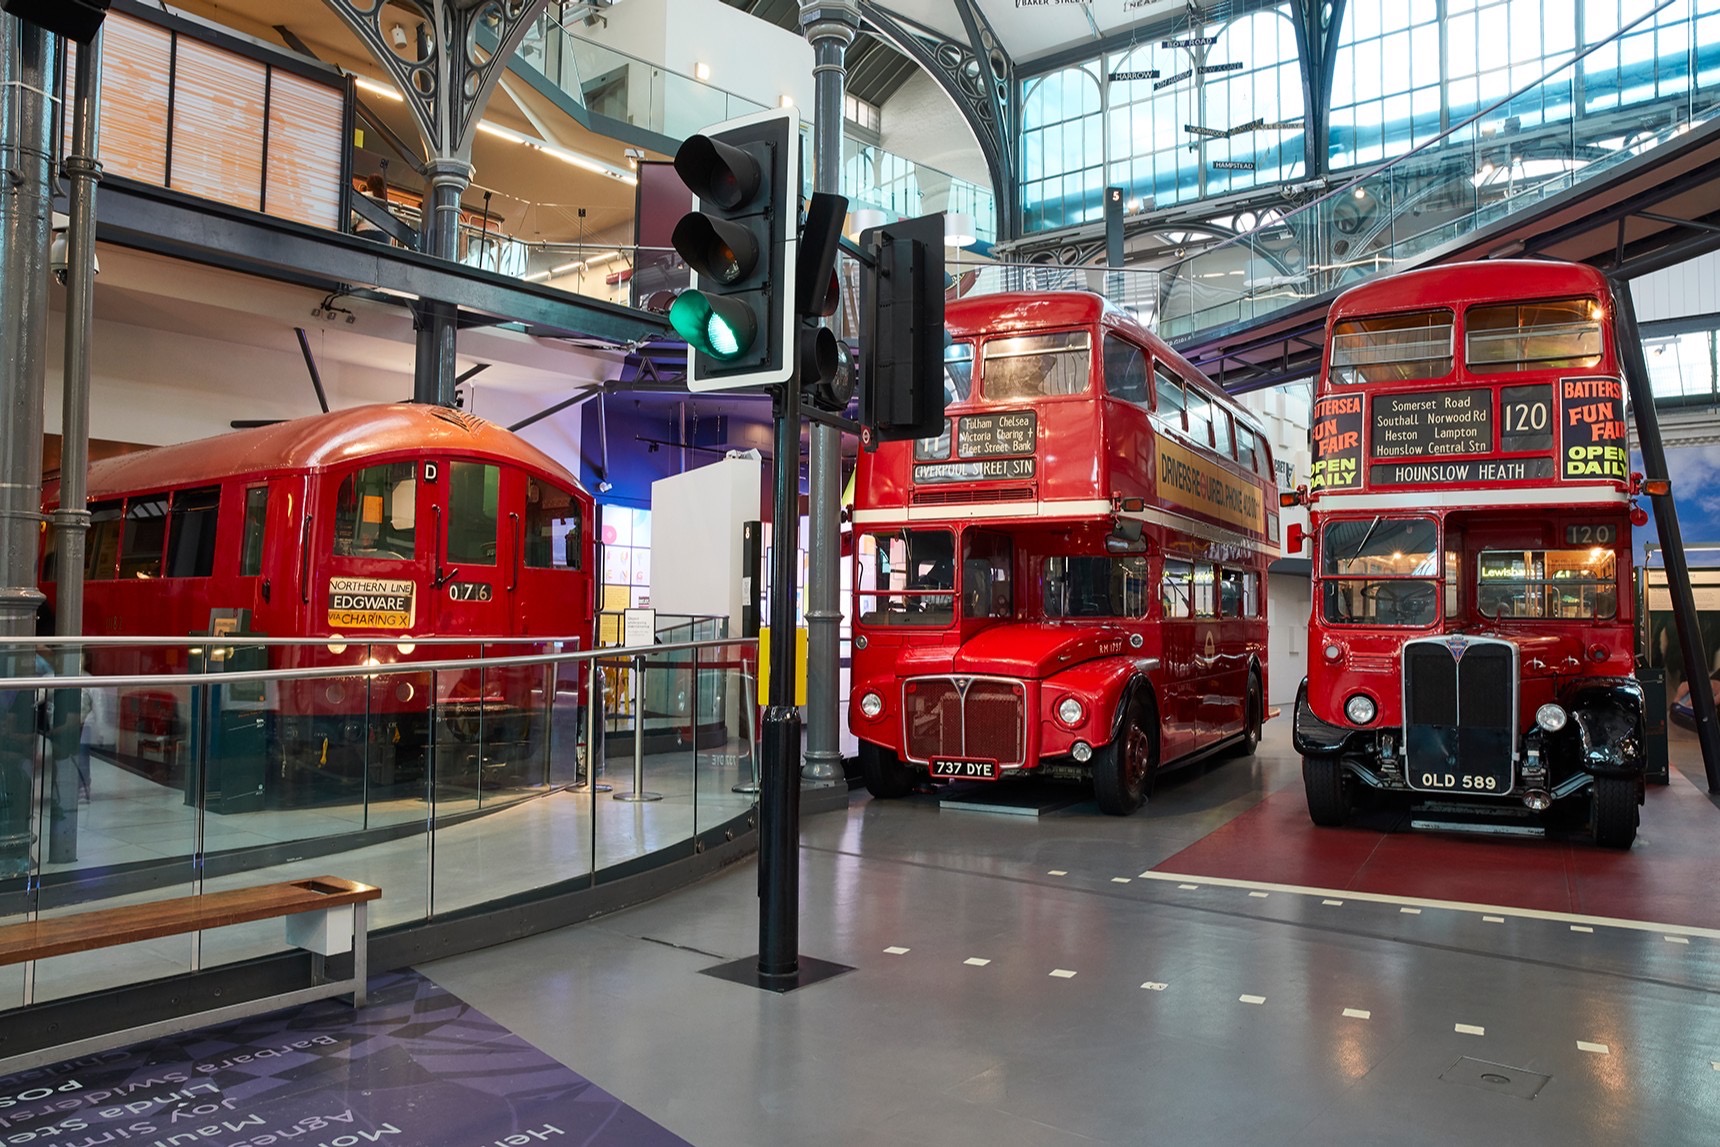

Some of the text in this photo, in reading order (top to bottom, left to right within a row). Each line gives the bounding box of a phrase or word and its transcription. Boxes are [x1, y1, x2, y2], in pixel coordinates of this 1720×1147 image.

[1189, 38, 1212, 46] ROAD
[1115, 72, 1153, 80] HARROW
[1190, 126, 1226, 138] NORTHWOOD
[1112, 190, 1120, 201] 5
[1564, 381, 1622, 400] BATTERS
[1314, 398, 1360, 418] TTERSEA
[1392, 396, 1471, 412] Somerset Road
[1377, 410, 1486, 427] Southall Norwood Rd
[1505, 402, 1547, 432] 120
[1568, 402, 1614, 426] FUN
[966, 416, 1029, 430] Fulham Chelsea
[1313, 419, 1338, 440] UN
[962, 432, 992, 442] Victoria
[996, 428, 1024, 440] Charing
[1385, 427, 1478, 442] Heston Lampton
[962, 441, 1032, 454] Fleet Street Bank
[1319, 431, 1359, 456] FAIR
[1376, 440, 1486, 456] Hounslow Central Stn
[426, 462, 436, 479] D
[914, 460, 1032, 478] LIVERPOOL STREET STN
[1162, 453, 1191, 494] DRIVERS
[1395, 464, 1525, 482] HOUNSLOW HEATH
[745, 526, 750, 539] 8
[1572, 526, 1609, 544] 120
[330, 580, 411, 593] NORTHERN LINE
[450, 584, 488, 600] 076
[334, 596, 404, 610] EDGWARE
[342, 614, 396, 625] CHARING
[399, 616, 408, 626] X
[1099, 644, 1109, 654] RM
[936, 762, 992, 776] 737 DYE
[1422, 773, 1496, 790] OLD 589
[0, 1035, 338, 1128] Barbara Swiders
[0, 1083, 220, 1147] Linda Ste
[48, 1097, 238, 1147] Joy Sim
[319, 1122, 402, 1147] Mo
